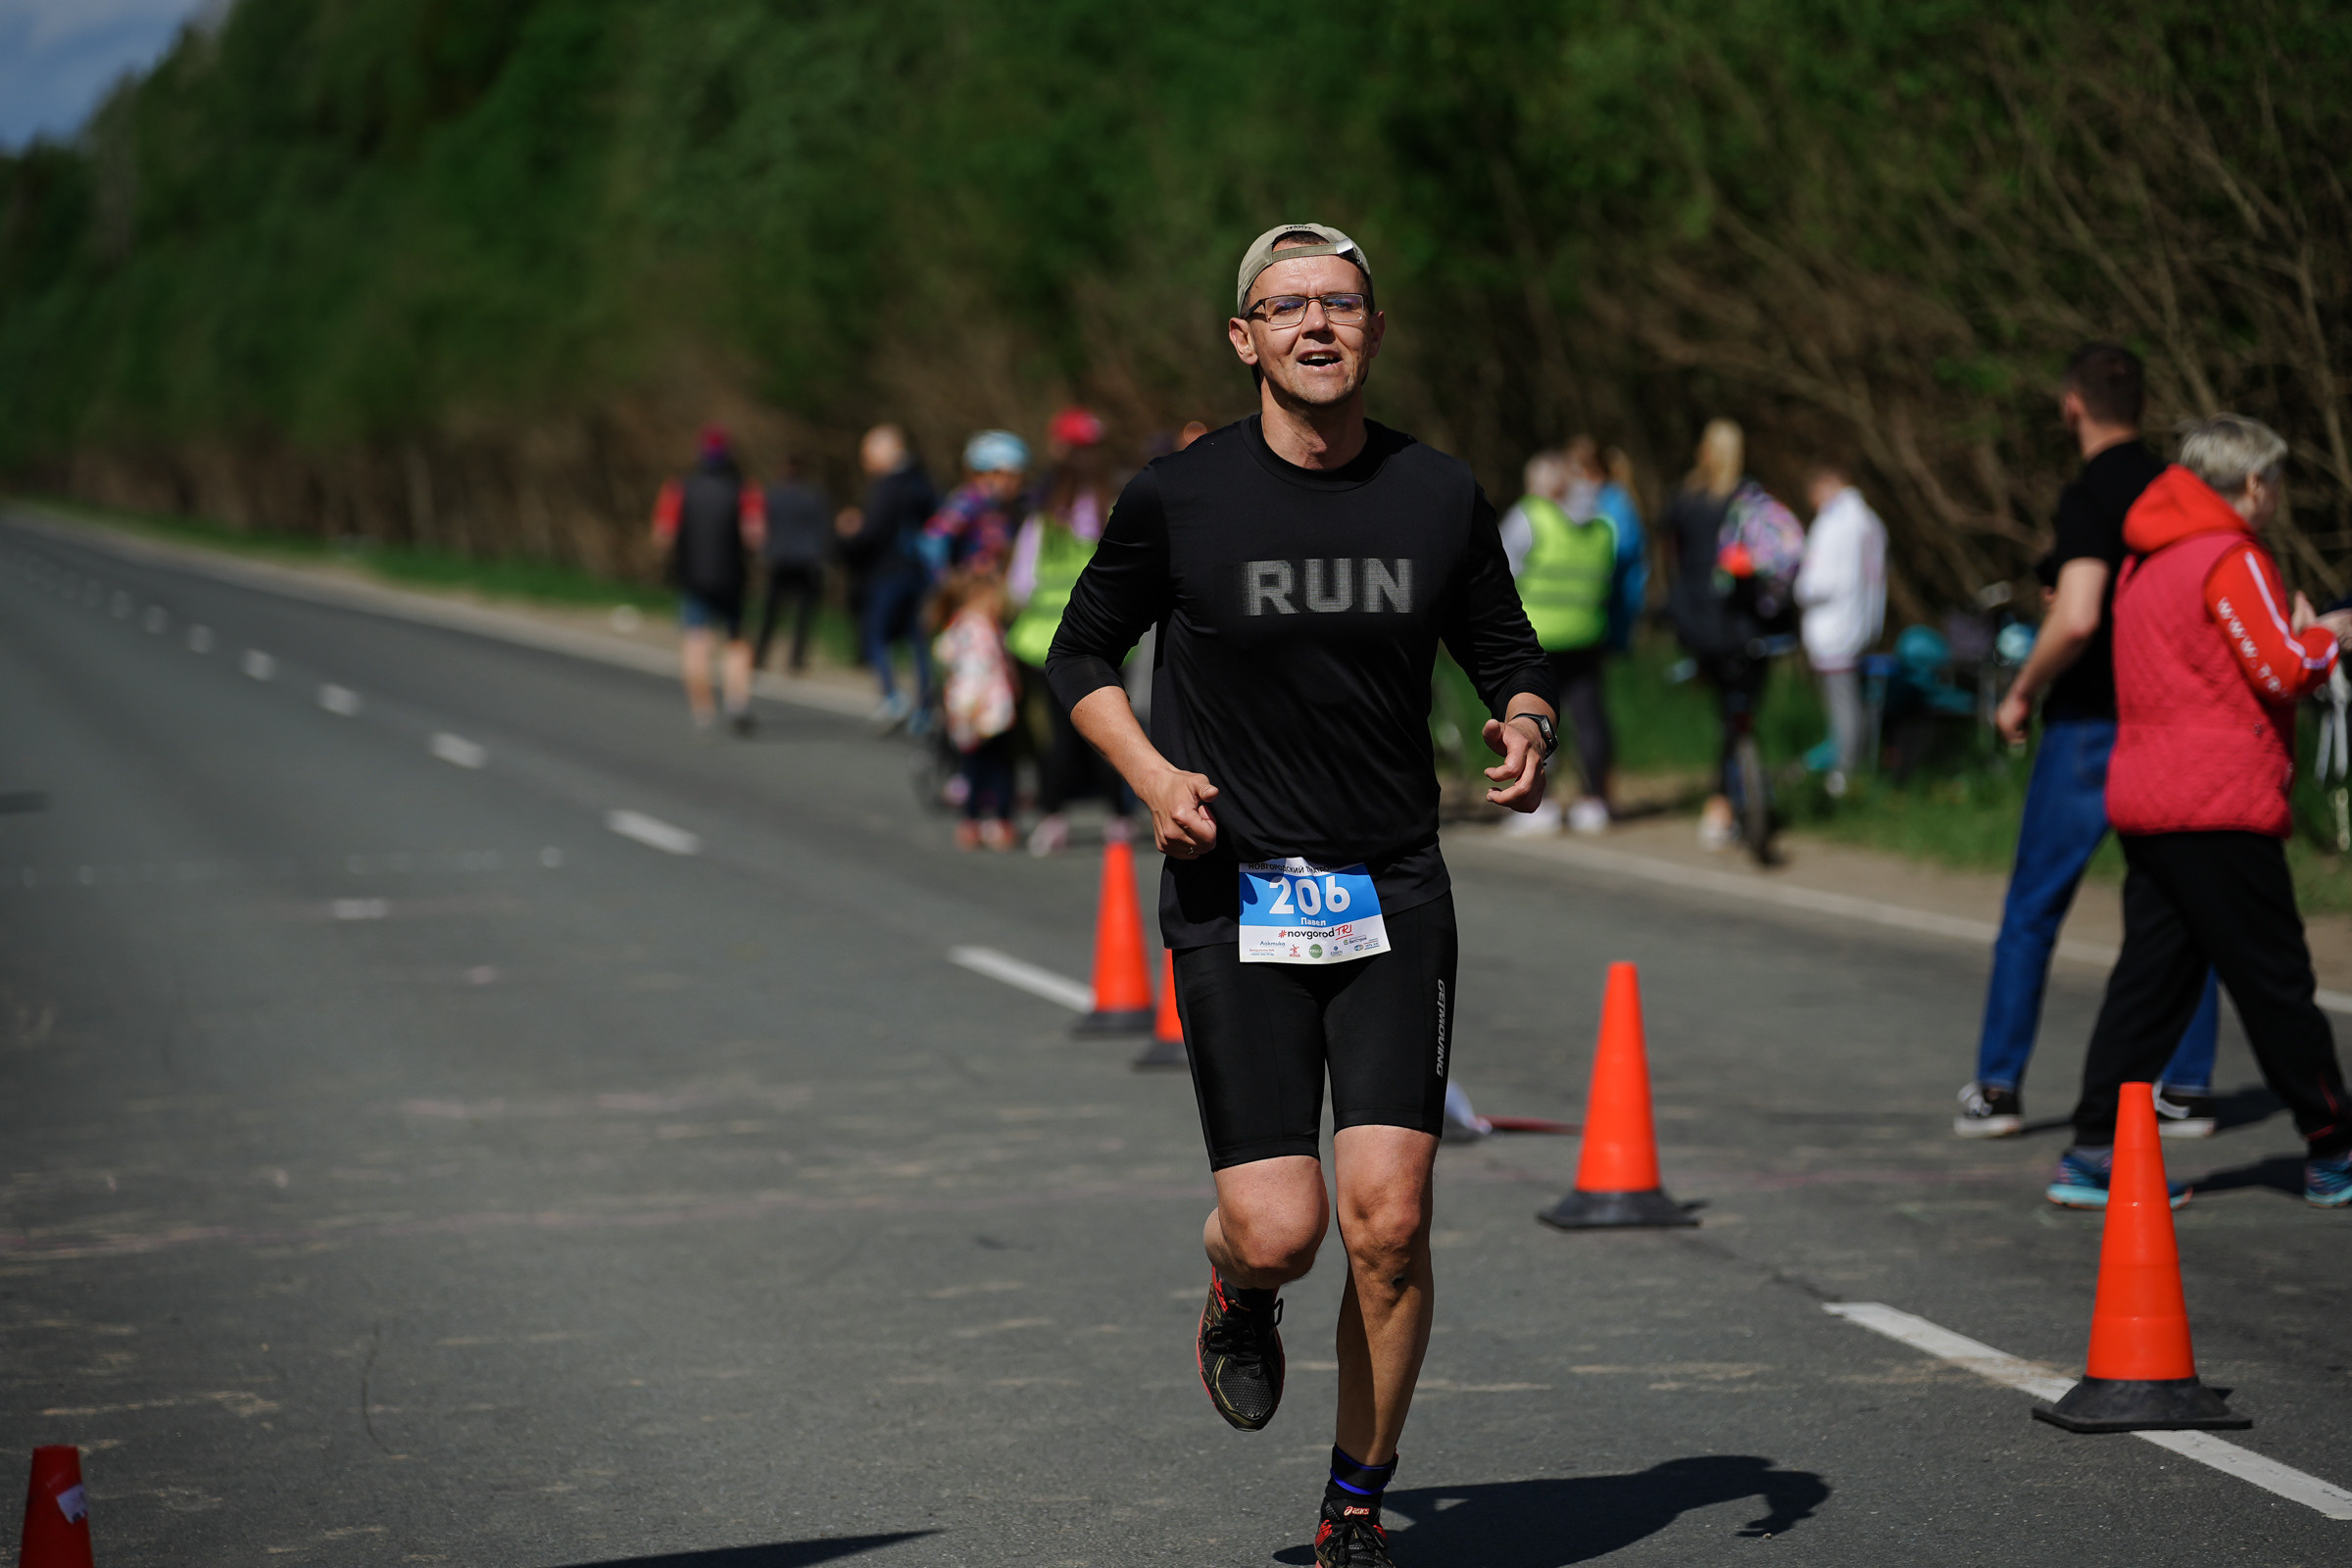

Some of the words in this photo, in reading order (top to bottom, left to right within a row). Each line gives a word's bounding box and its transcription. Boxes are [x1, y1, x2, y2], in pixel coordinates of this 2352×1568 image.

[1242, 558, 1413, 615] RUN
[1268, 875, 1351, 916] 206
[1300, 916, 1327, 926] Павел
